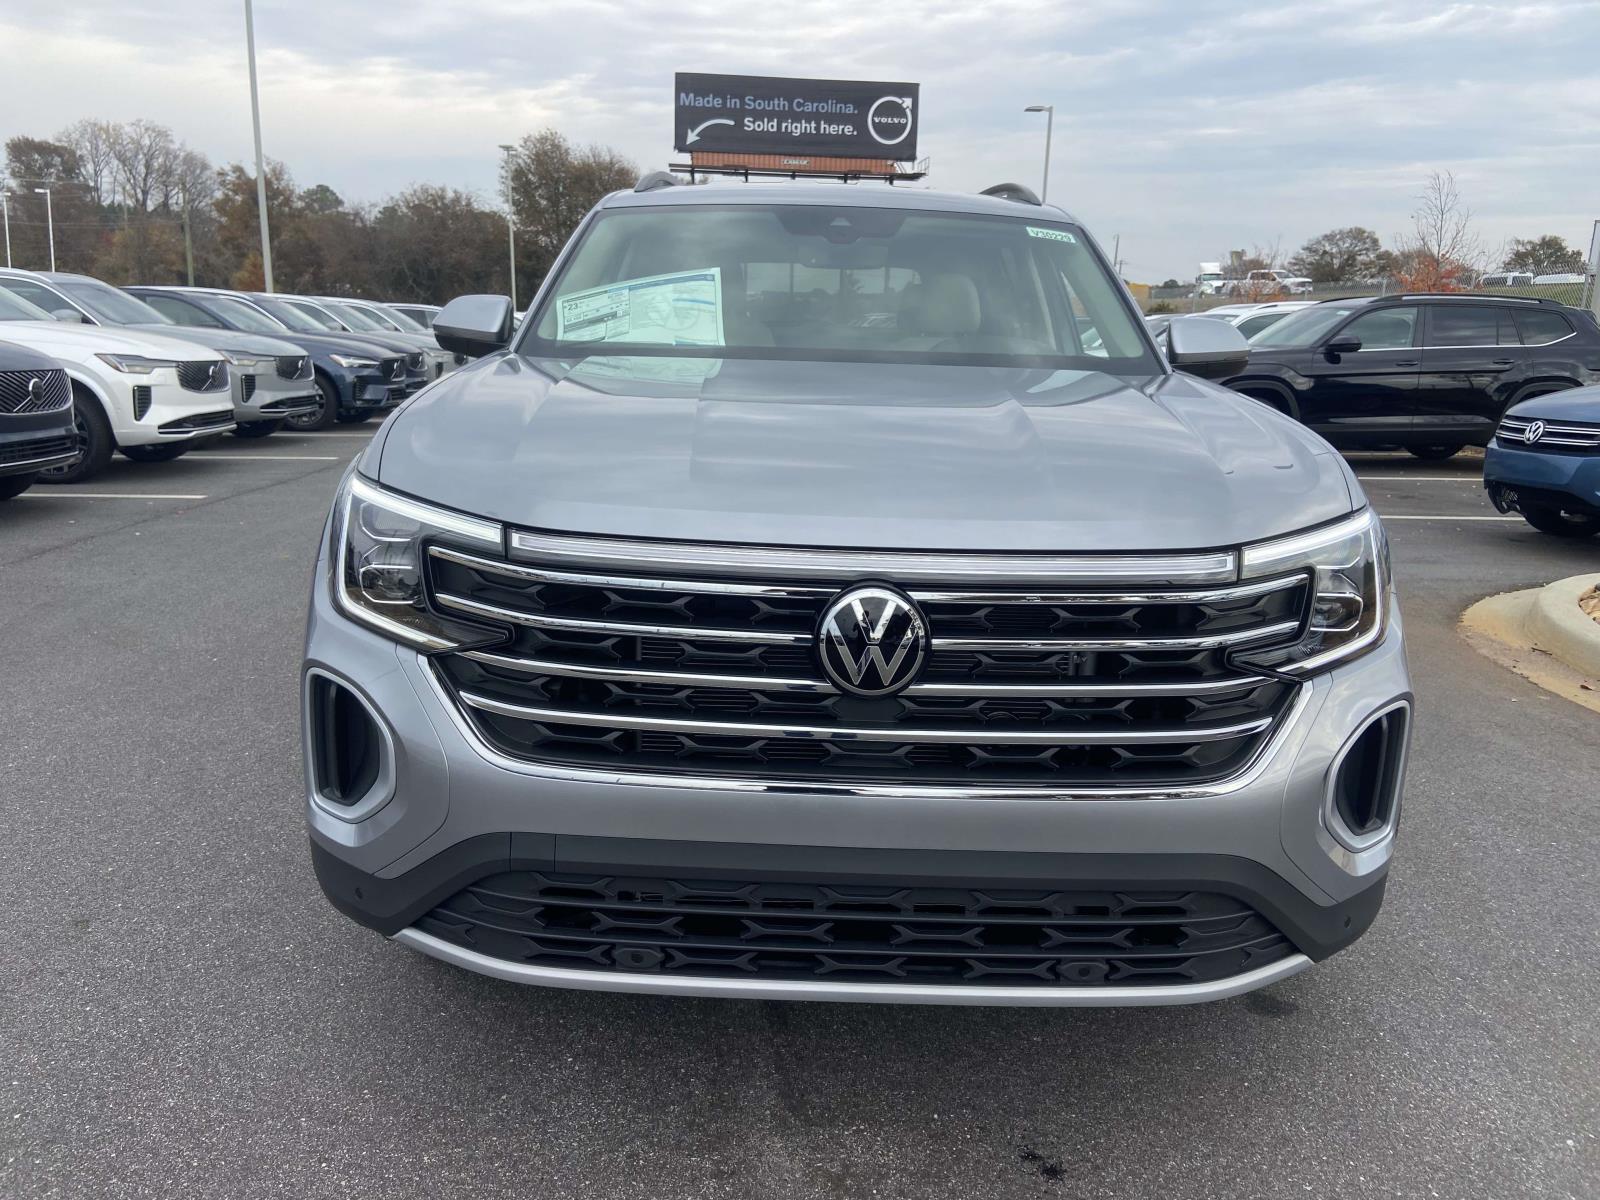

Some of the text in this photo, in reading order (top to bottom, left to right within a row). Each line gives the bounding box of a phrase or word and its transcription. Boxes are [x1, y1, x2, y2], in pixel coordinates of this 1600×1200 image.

[679, 92, 858, 114] Made in South Carolina.
[743, 117, 858, 136] Sold right here.
[873, 116, 907, 124] VOLVO
[567, 302, 579, 311] 23
